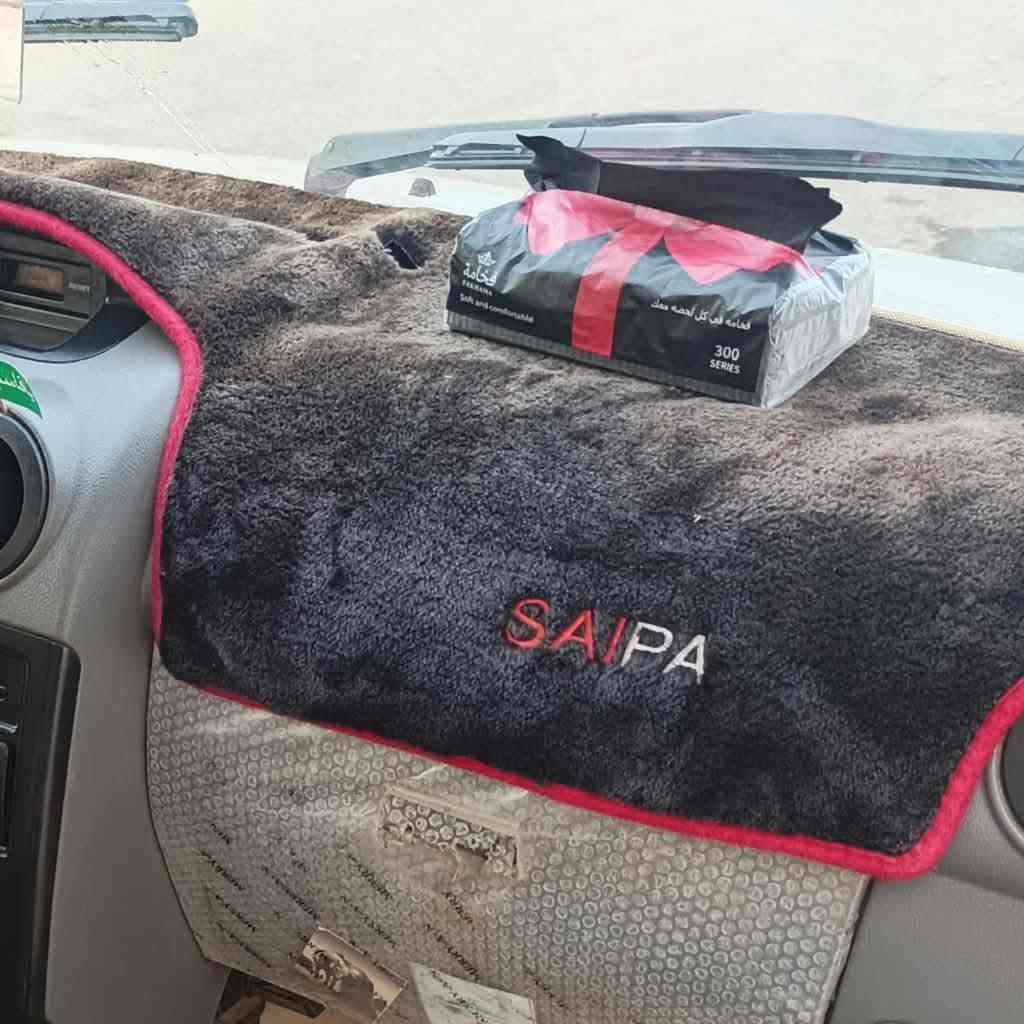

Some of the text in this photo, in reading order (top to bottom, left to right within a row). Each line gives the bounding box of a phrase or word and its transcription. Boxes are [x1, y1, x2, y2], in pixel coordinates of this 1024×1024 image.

[462, 261, 498, 287] فخامة
[460, 292, 535, 323] Soft and comfortable
[713, 344, 740, 362] 300
[709, 358, 741, 375] SERIES
[504, 597, 706, 685] SAIPA
